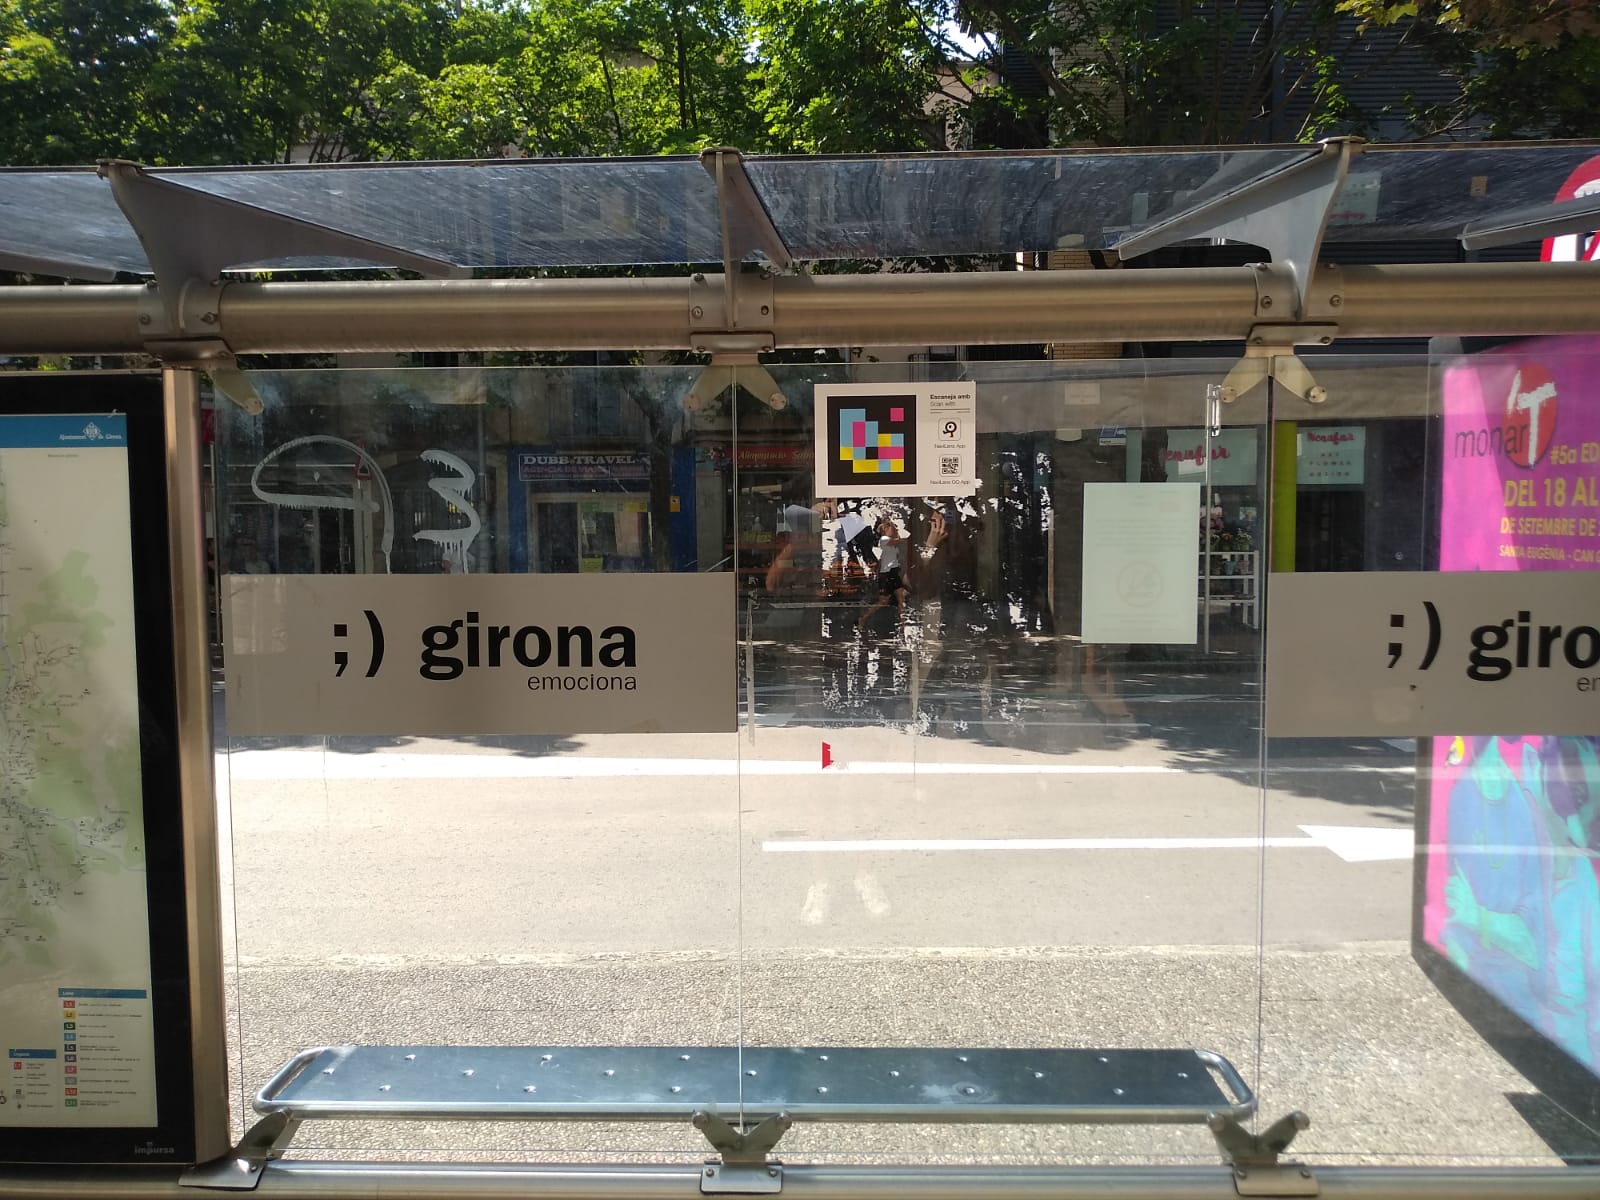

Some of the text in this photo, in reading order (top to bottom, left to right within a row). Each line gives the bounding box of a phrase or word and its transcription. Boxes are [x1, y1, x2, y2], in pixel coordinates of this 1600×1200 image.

[1504, 476, 1599, 507] DEL 18 AL
[1500, 517, 1516, 534] DE
[1518, 517, 1576, 535] SETEMBRE
[1579, 518, 1597, 536] DE
[419, 611, 637, 681] girona
[1466, 610, 1600, 682] giro
[527, 672, 637, 690] emociona
